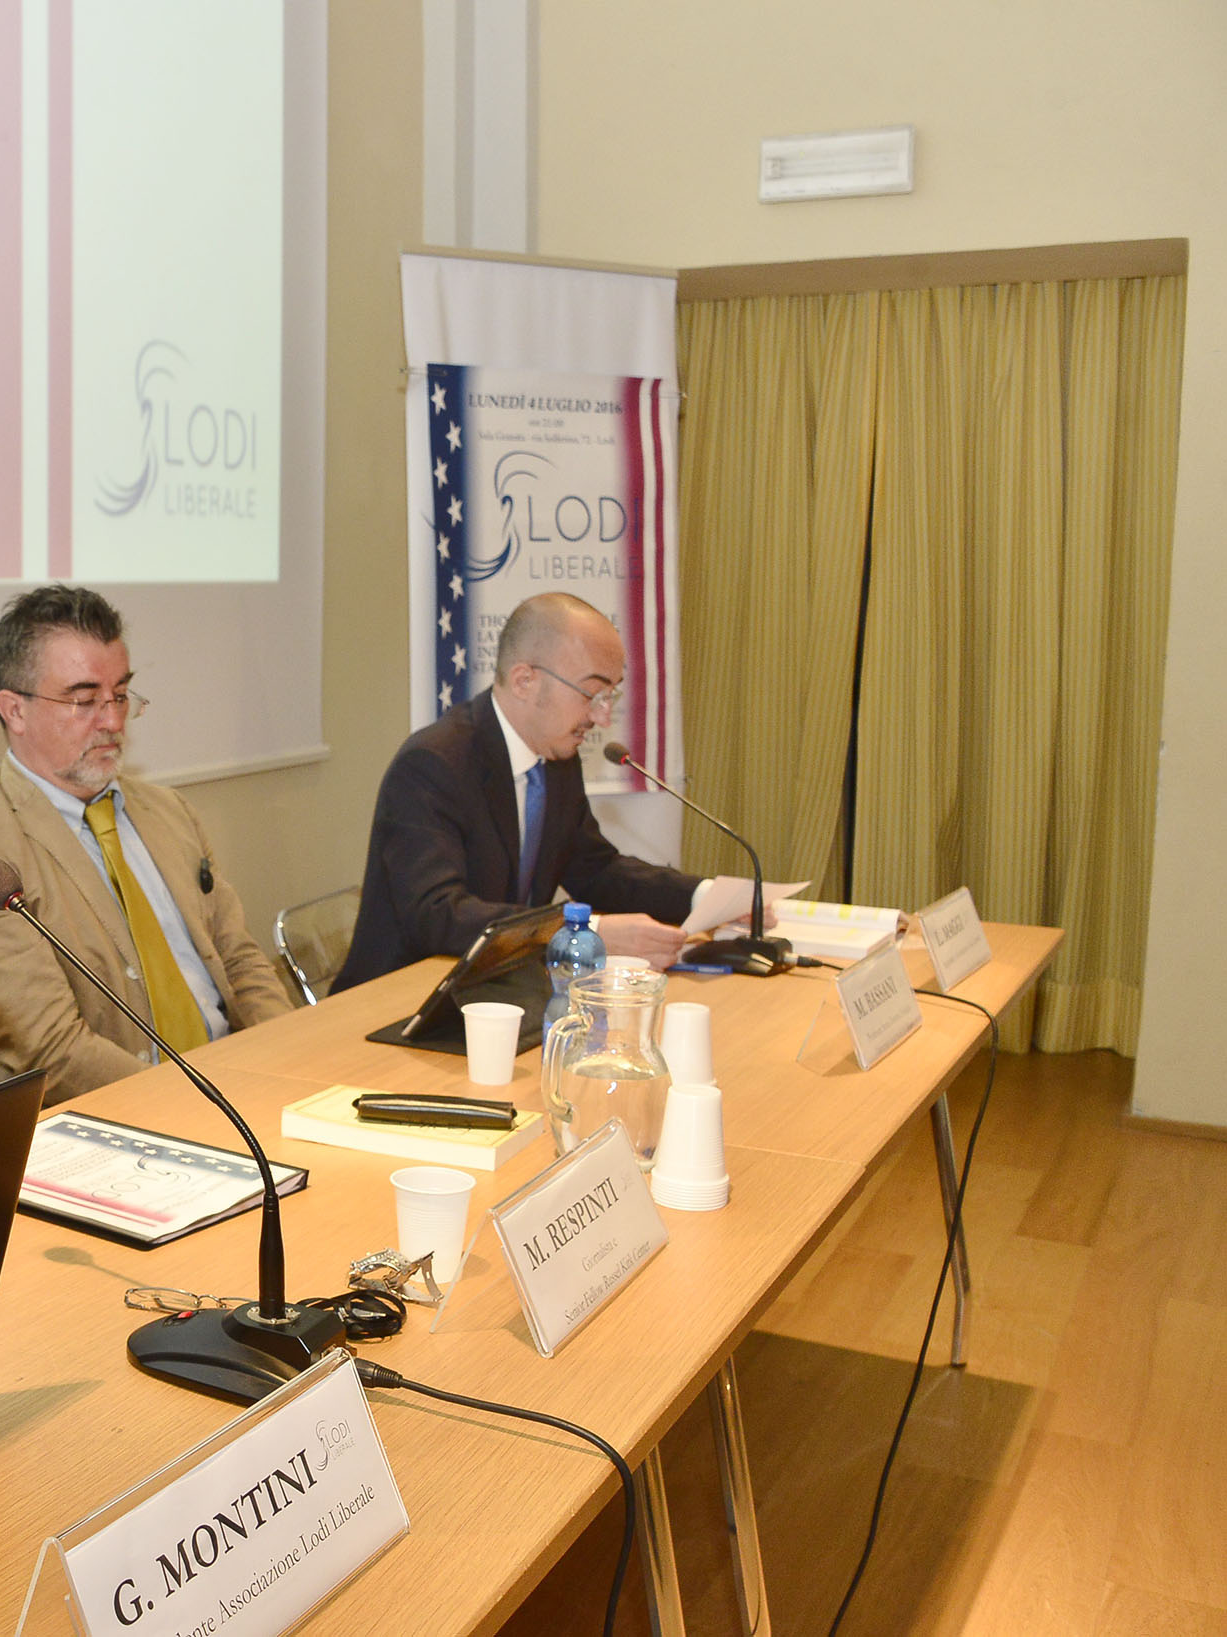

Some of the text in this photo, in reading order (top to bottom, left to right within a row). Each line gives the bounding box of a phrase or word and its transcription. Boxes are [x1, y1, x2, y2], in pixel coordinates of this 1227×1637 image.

[537, 397, 591, 412] LUGLIO
[164, 399, 256, 471] LODI
[164, 484, 256, 519] LIBERALE
[528, 495, 639, 543] LODI
[529, 555, 641, 580] LIBERALE
[865, 976, 898, 1015] BASSANI
[523, 1177, 619, 1271] M. RESPINTI
[325, 1420, 351, 1448] LODI
[112, 1448, 318, 1627] G. MONTINI
[220, 1484, 375, 1625] Associazione Lodi Liberale
